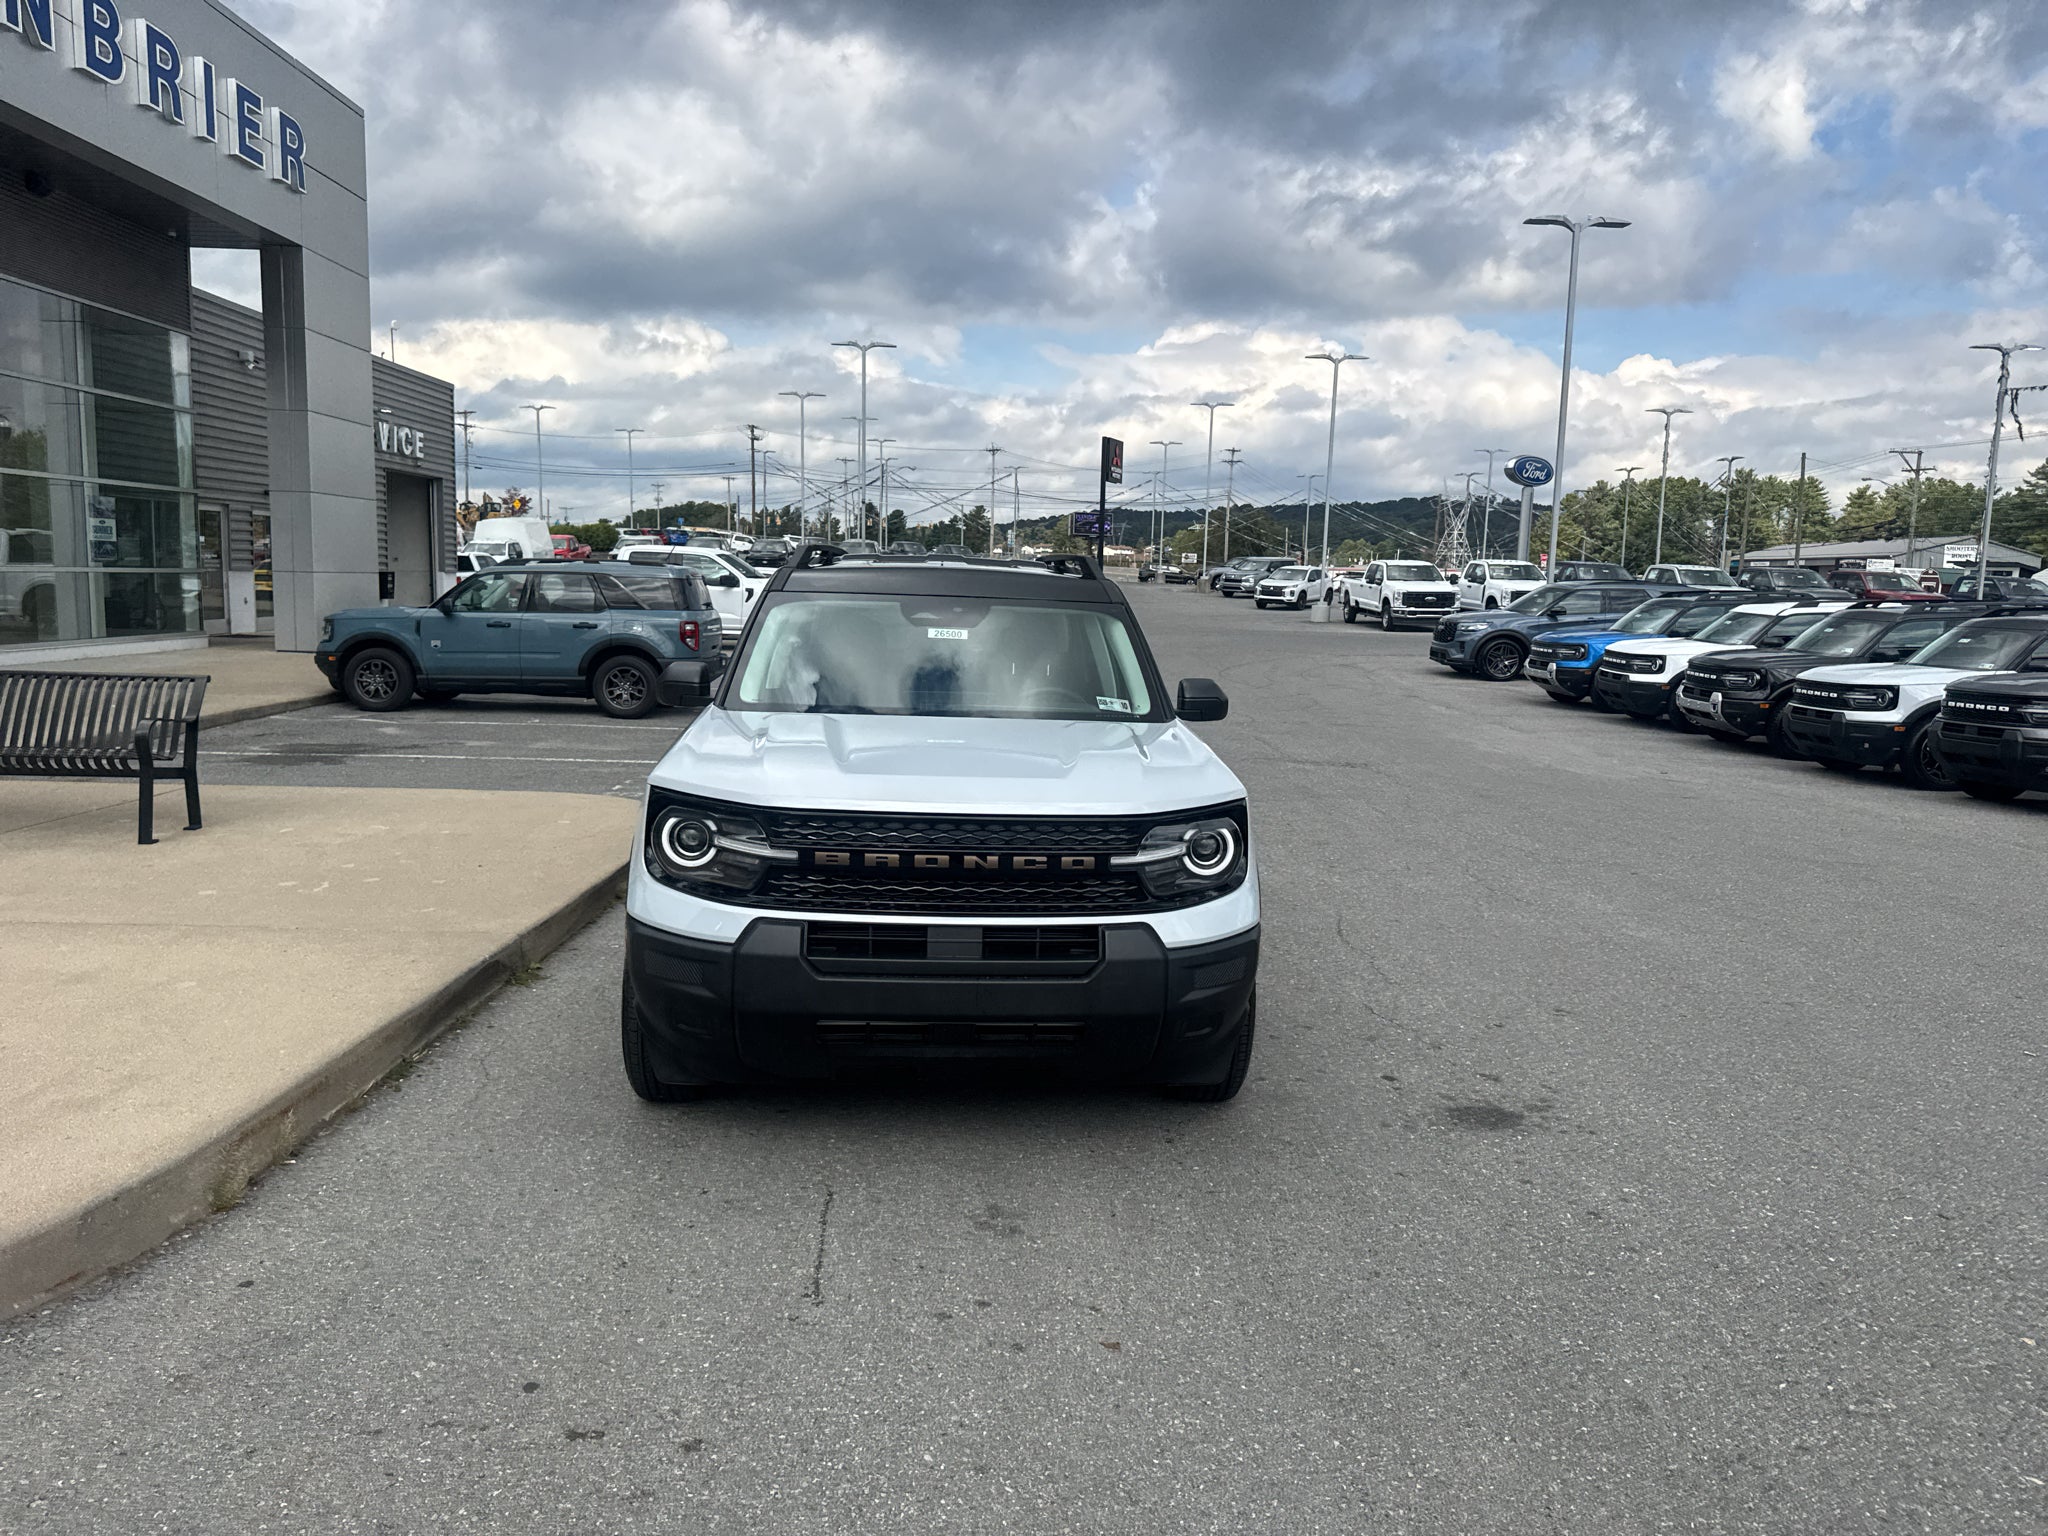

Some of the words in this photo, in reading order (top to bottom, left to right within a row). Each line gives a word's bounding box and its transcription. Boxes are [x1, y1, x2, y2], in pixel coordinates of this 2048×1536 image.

[378, 421, 424, 459] VICE
[1522, 461, 1548, 481] Ford
[934, 629, 963, 639] 26500
[1795, 688, 1838, 698] BRONCO
[1947, 701, 2010, 712] BRONCO
[814, 851, 1096, 870] BRONCO
